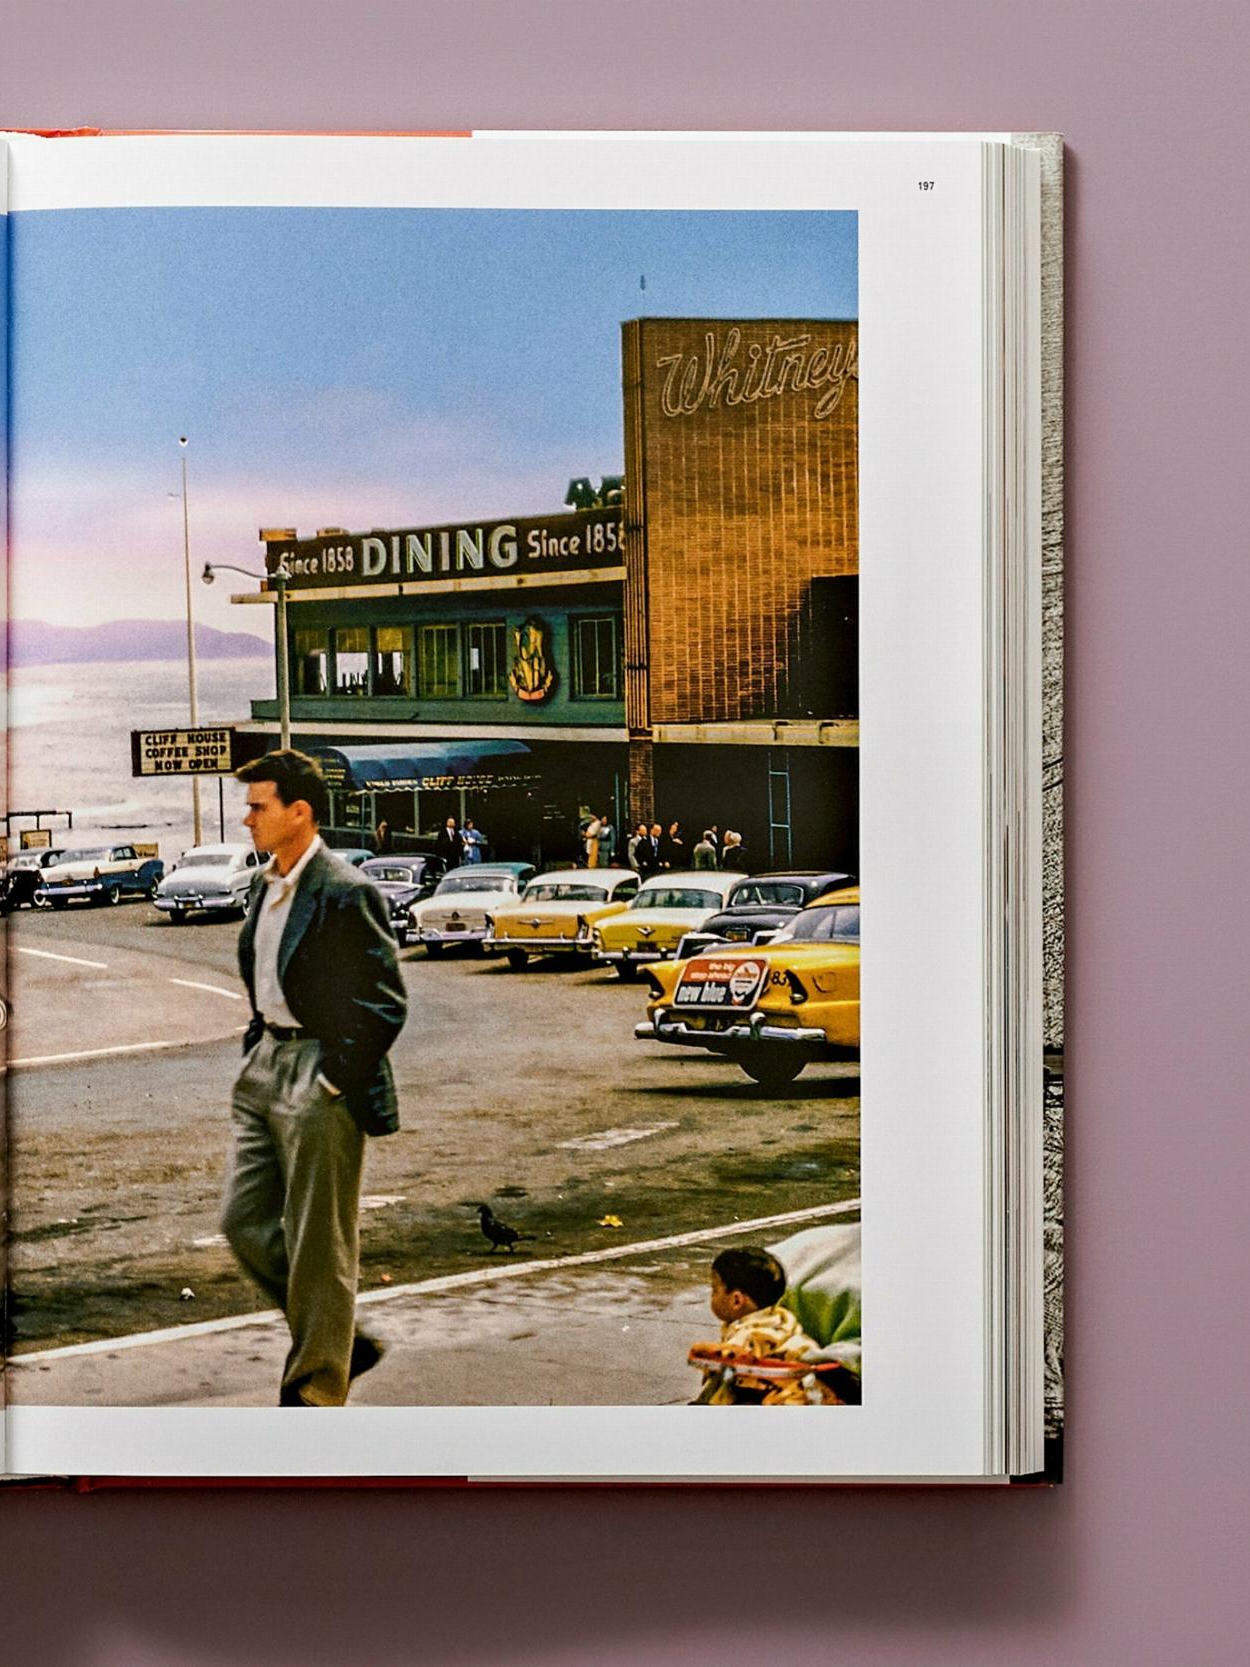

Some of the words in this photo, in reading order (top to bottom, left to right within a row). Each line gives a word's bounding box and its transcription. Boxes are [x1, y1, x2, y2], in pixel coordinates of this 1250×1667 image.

[918, 181, 935, 191] 197
[656, 327, 858, 419] Whitney
[279, 551, 318, 575] Since
[322, 545, 354, 573] 1858
[362, 524, 518, 576] DINING
[527, 529, 581, 559] Since
[145, 734, 177, 746] CLIFF
[187, 732, 226, 744] HOUSE
[145, 746, 188, 758] COFFEE
[195, 745, 227, 757] SHOP
[154, 759, 182, 771] NOW
[188, 758, 219, 769] OPEN
